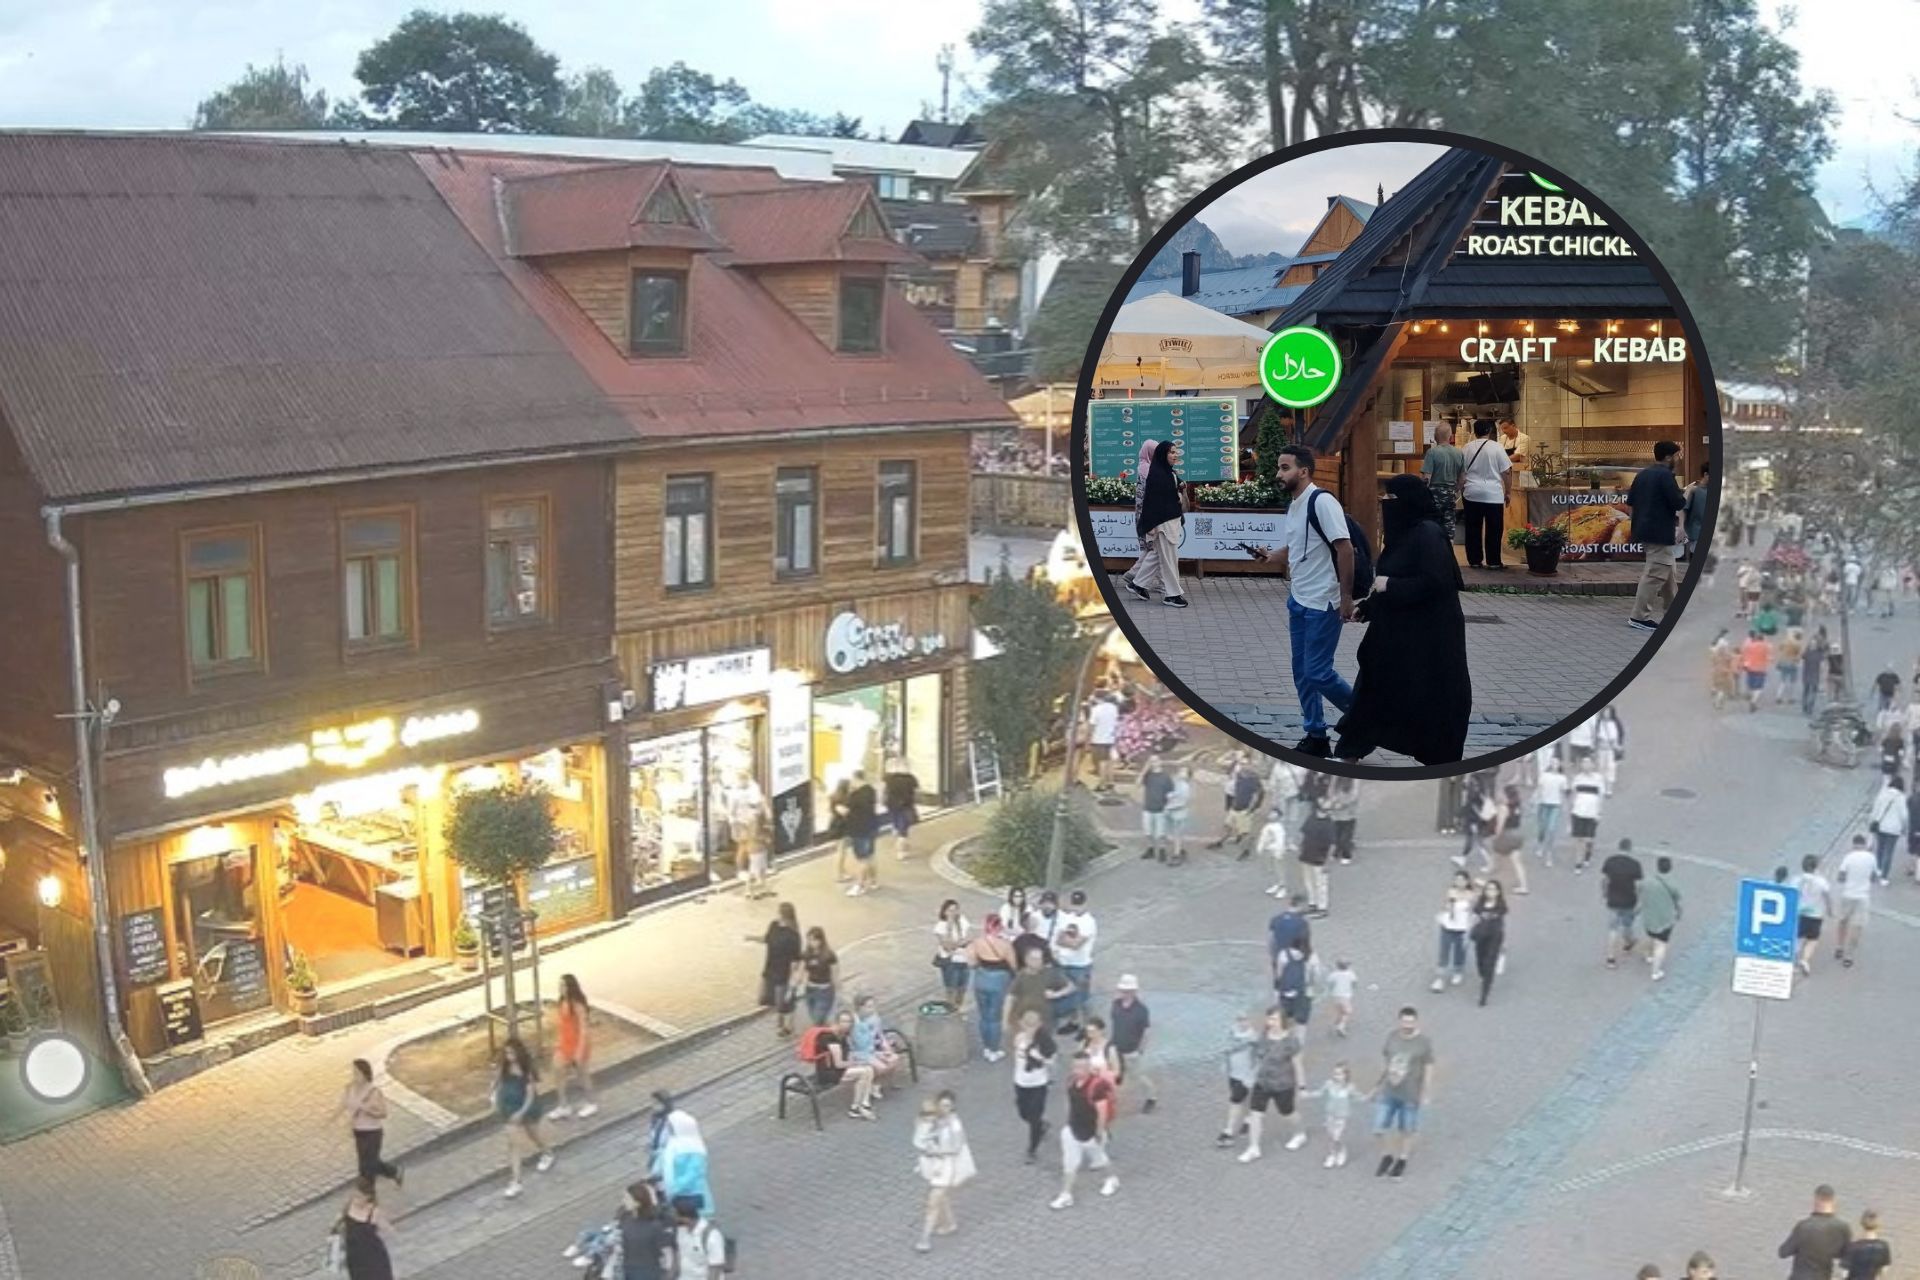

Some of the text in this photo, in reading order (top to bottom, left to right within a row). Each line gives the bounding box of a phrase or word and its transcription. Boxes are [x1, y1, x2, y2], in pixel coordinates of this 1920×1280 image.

[1468, 235, 1638, 256] ROAST CHICKE
[1460, 337, 1686, 363] CRAFT KEBAB
[1272, 352, 1326, 381] حلال
[1551, 494, 1608, 505] KURCZAKI
[1611, 494, 1619, 504] Z
[1248, 521, 1276, 532] القائمة
[1602, 543, 1644, 553] CHICKE
[1751, 889, 1786, 935] P
